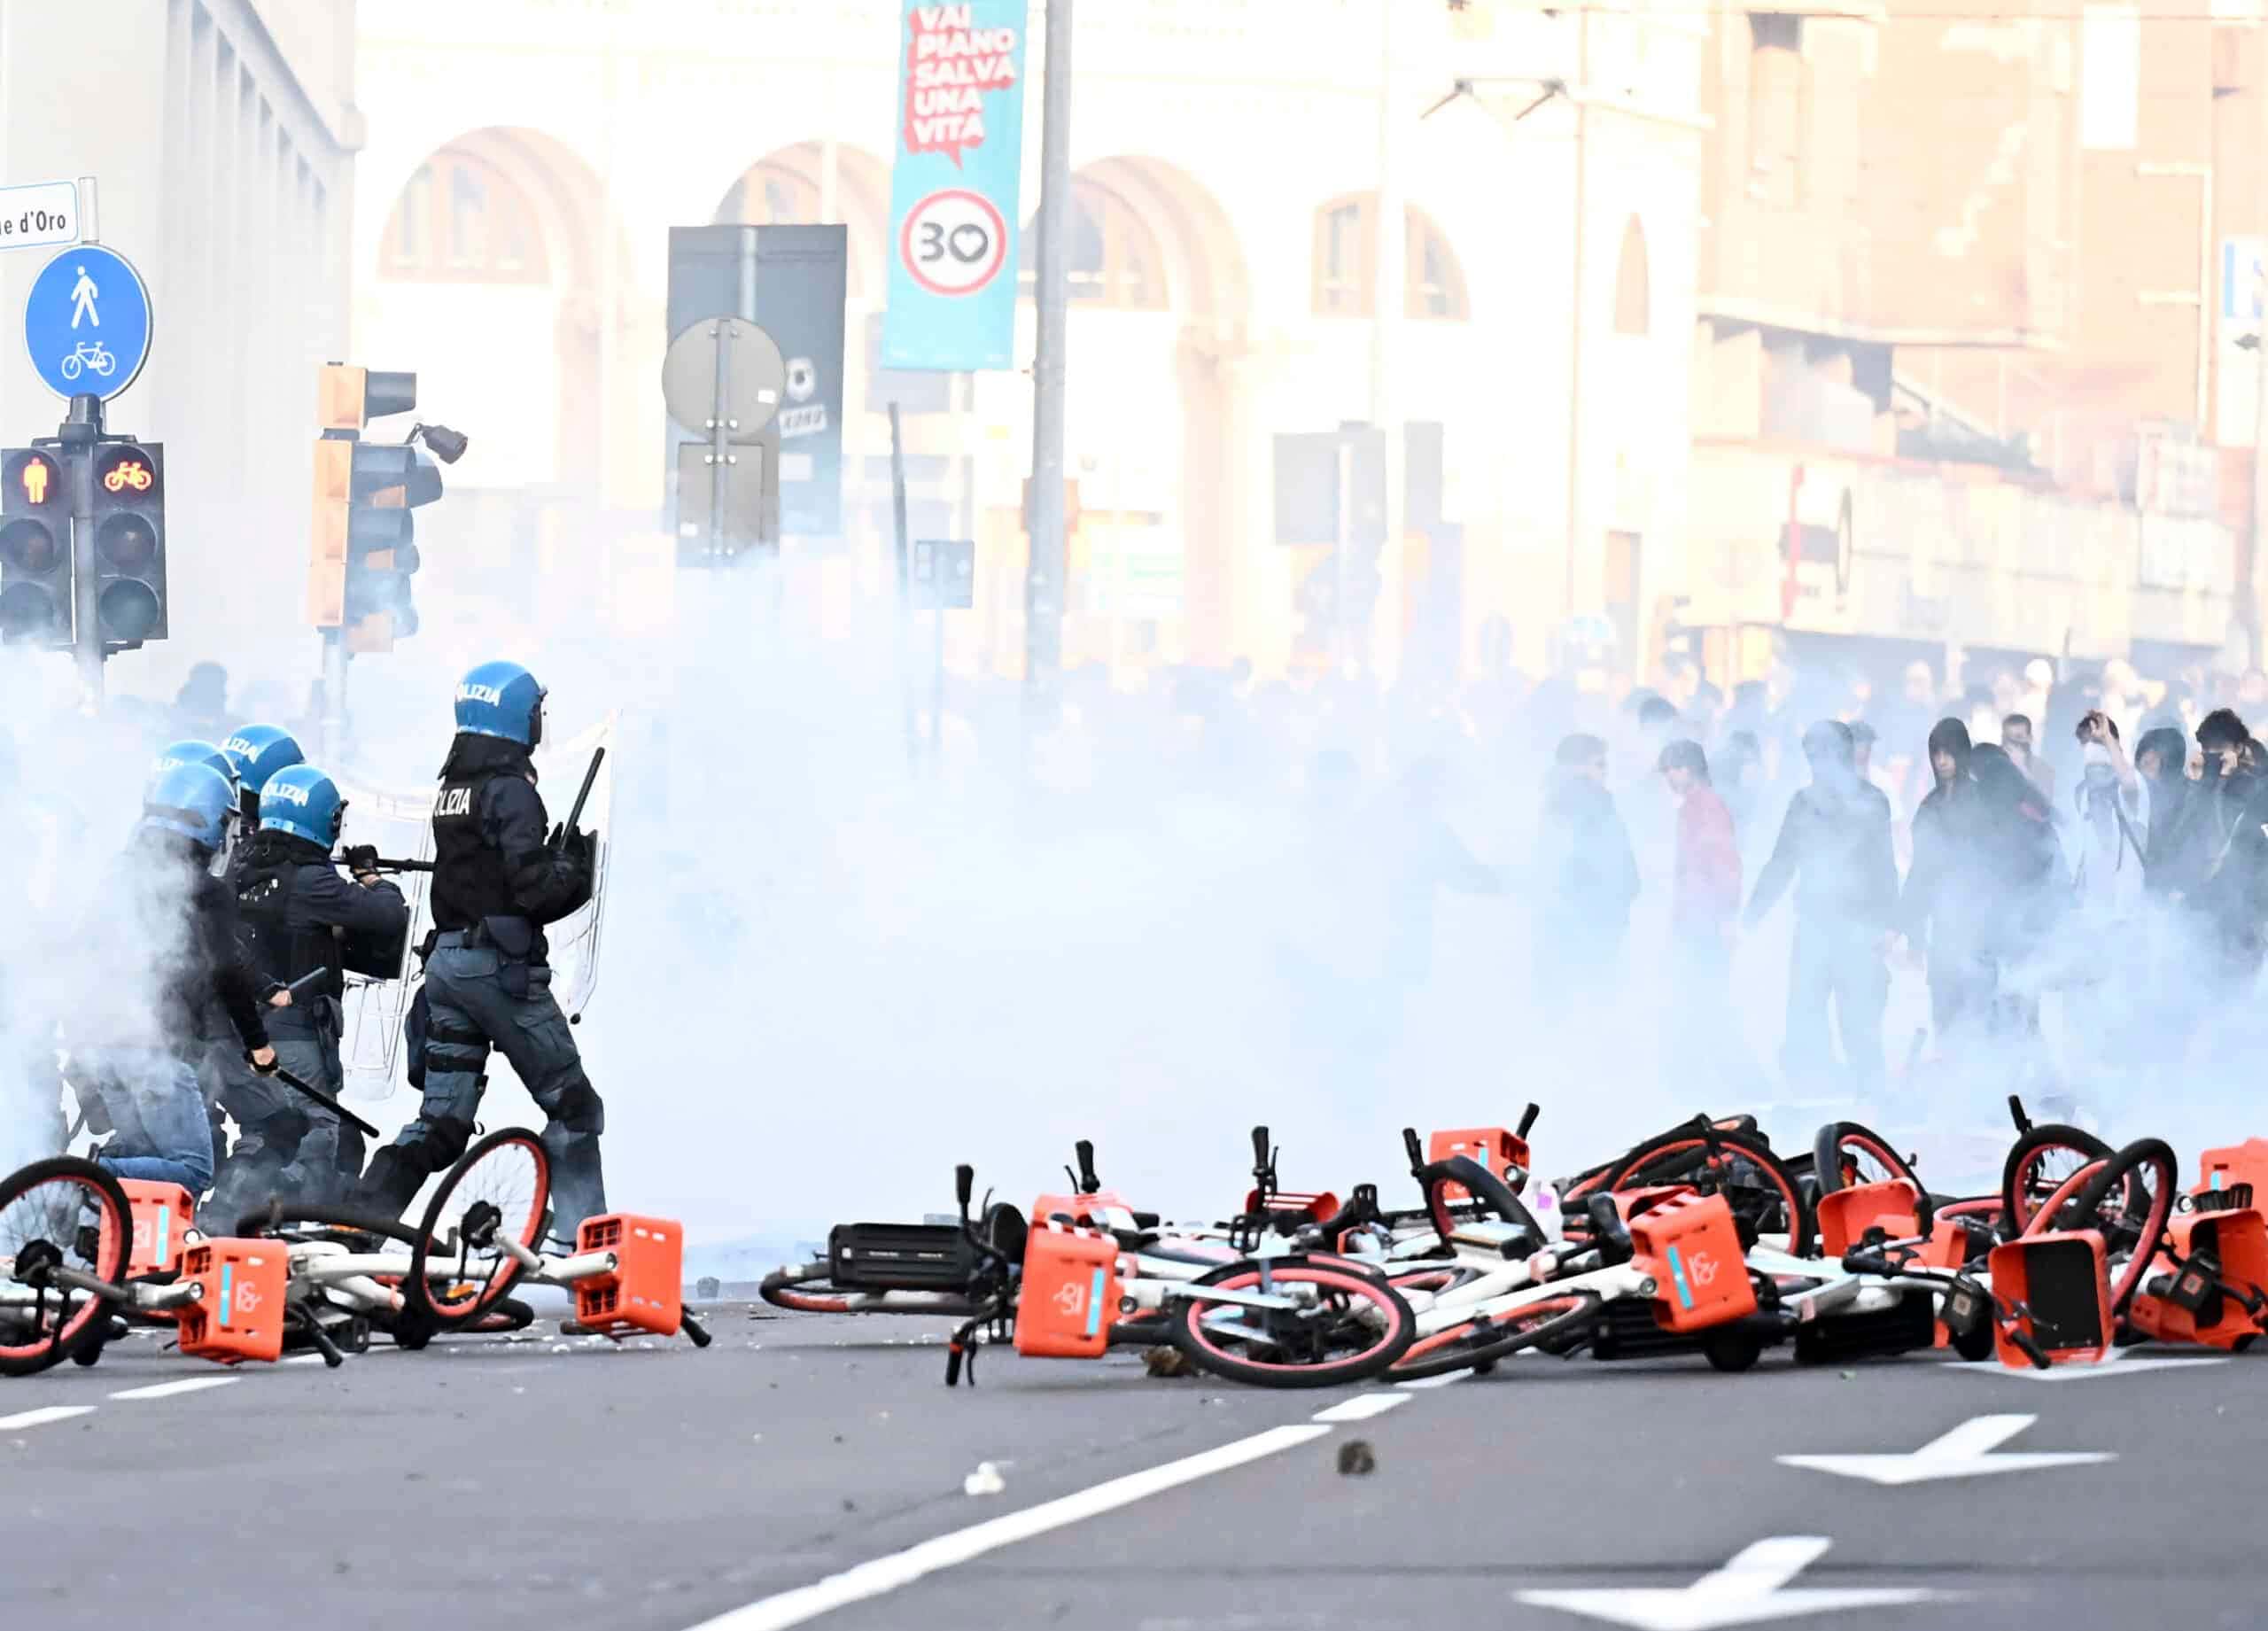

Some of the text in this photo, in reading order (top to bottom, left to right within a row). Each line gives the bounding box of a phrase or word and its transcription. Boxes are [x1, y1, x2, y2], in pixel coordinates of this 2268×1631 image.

[916, 4, 971, 31] VAI
[915, 27, 1015, 59] PIANO
[914, 55, 1016, 88] SALVA
[913, 87, 982, 115] UNA
[913, 113, 984, 143] VITA
[0, 209, 66, 236] e d'Oro
[919, 221, 990, 263] 30
[455, 680, 501, 708] OLIZIA
[261, 781, 309, 807] OLIZIA
